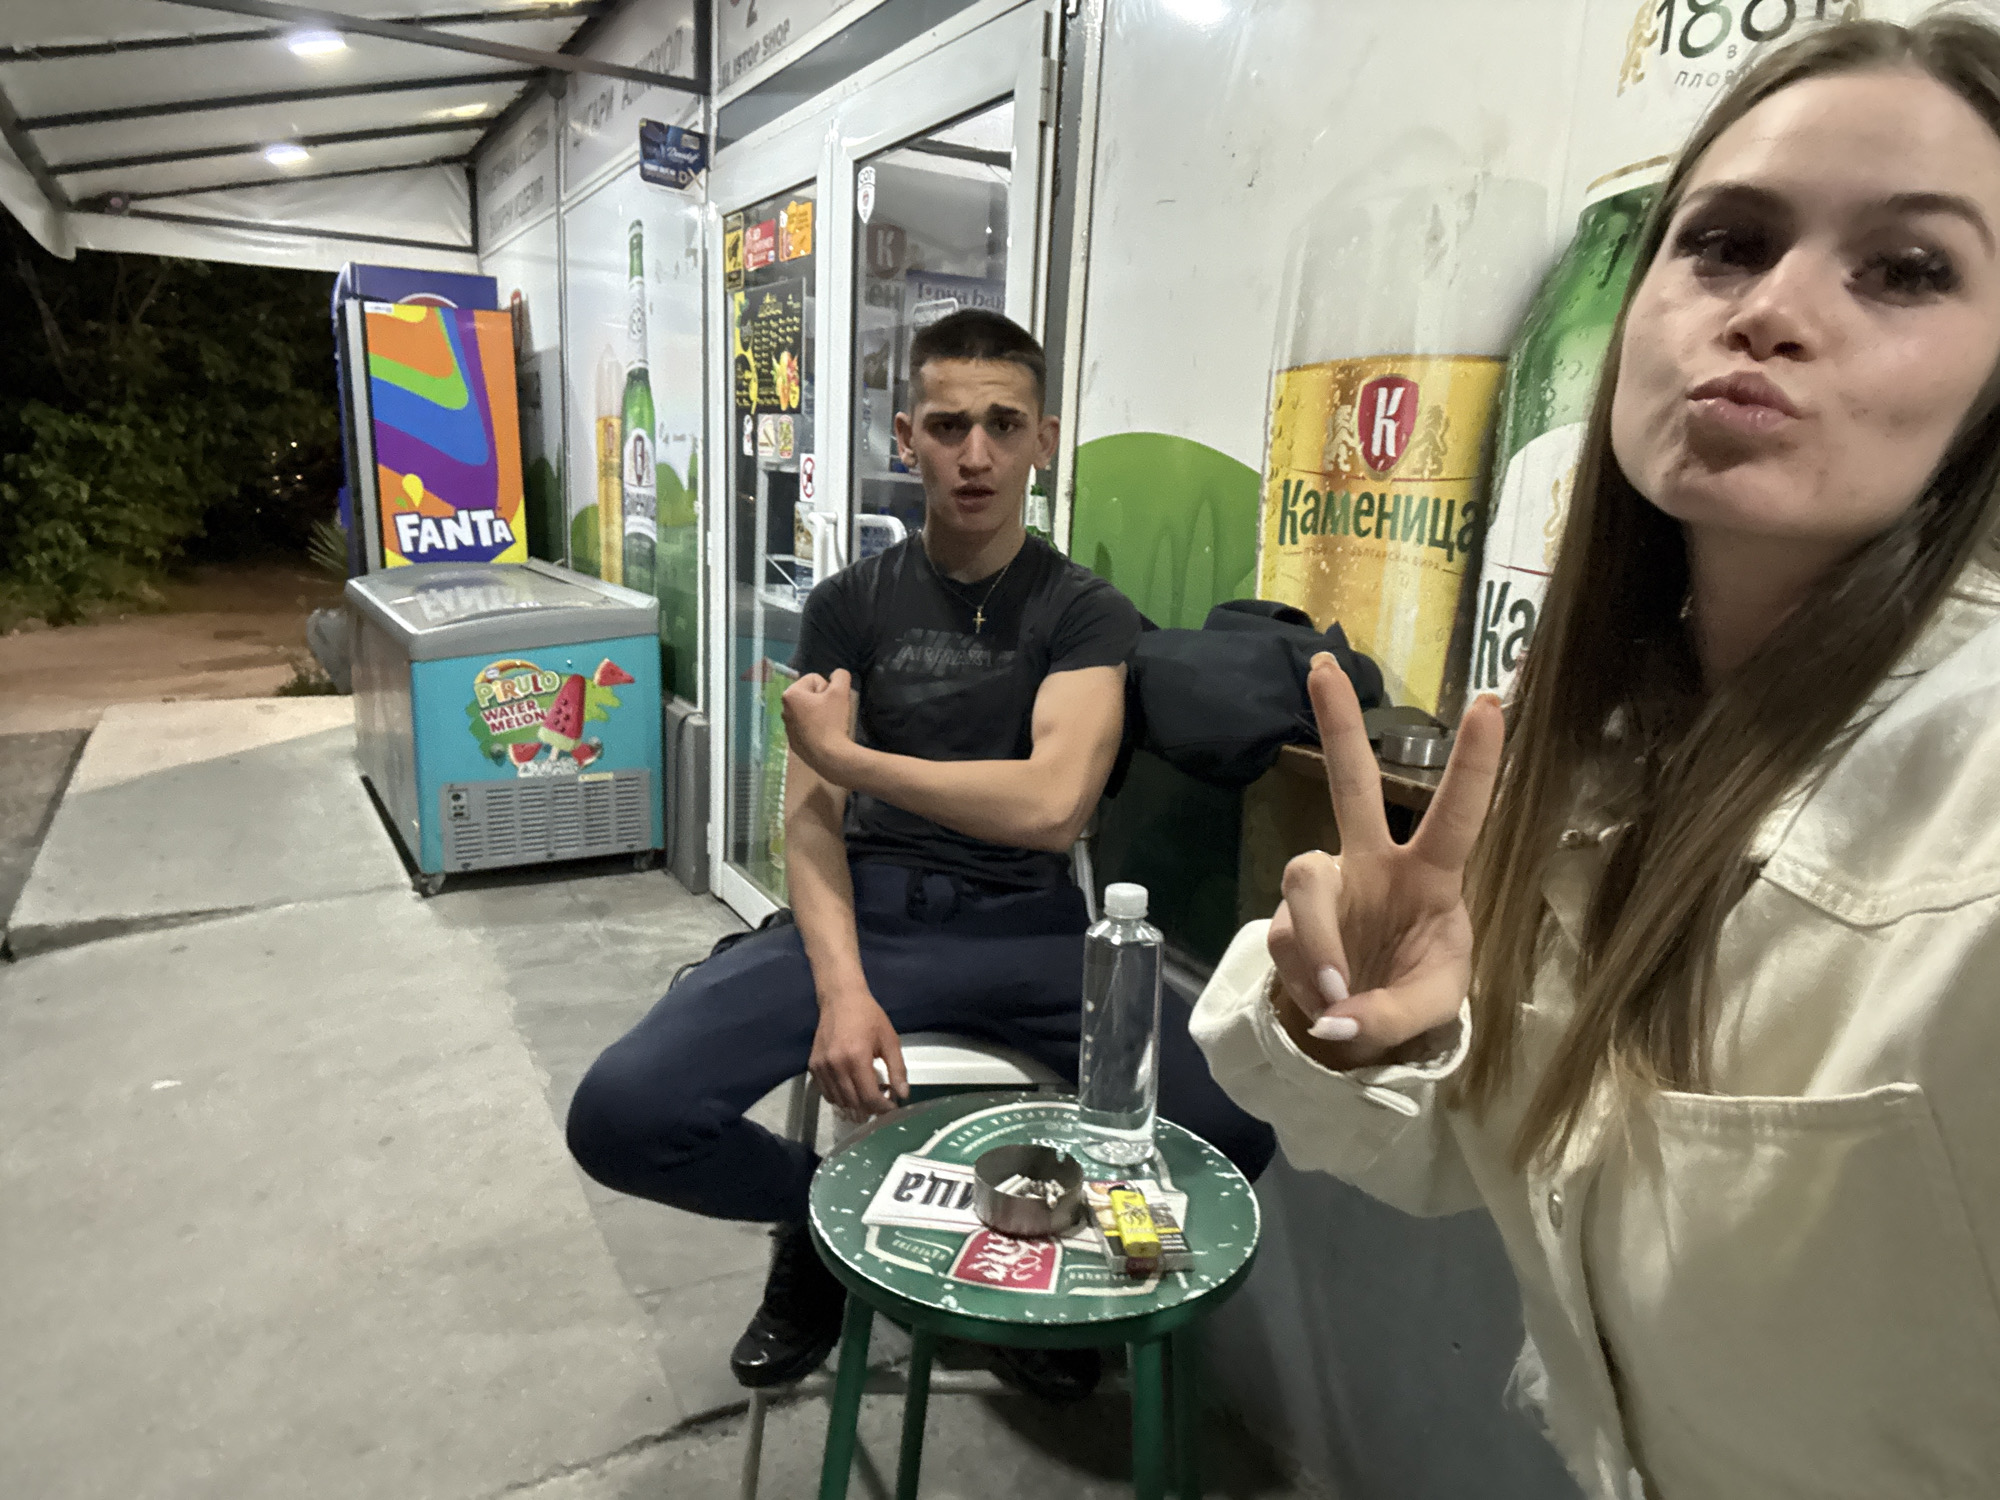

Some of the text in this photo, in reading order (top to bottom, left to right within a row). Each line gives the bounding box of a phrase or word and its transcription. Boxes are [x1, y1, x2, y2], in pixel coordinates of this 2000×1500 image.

[395, 509, 514, 554] FANTA
[1278, 479, 1488, 562] Каменица
[1473, 579, 1536, 690] Ка
[474, 671, 560, 707] PIRULO
[483, 700, 537, 722] WATER
[490, 709, 546, 735] MELON
